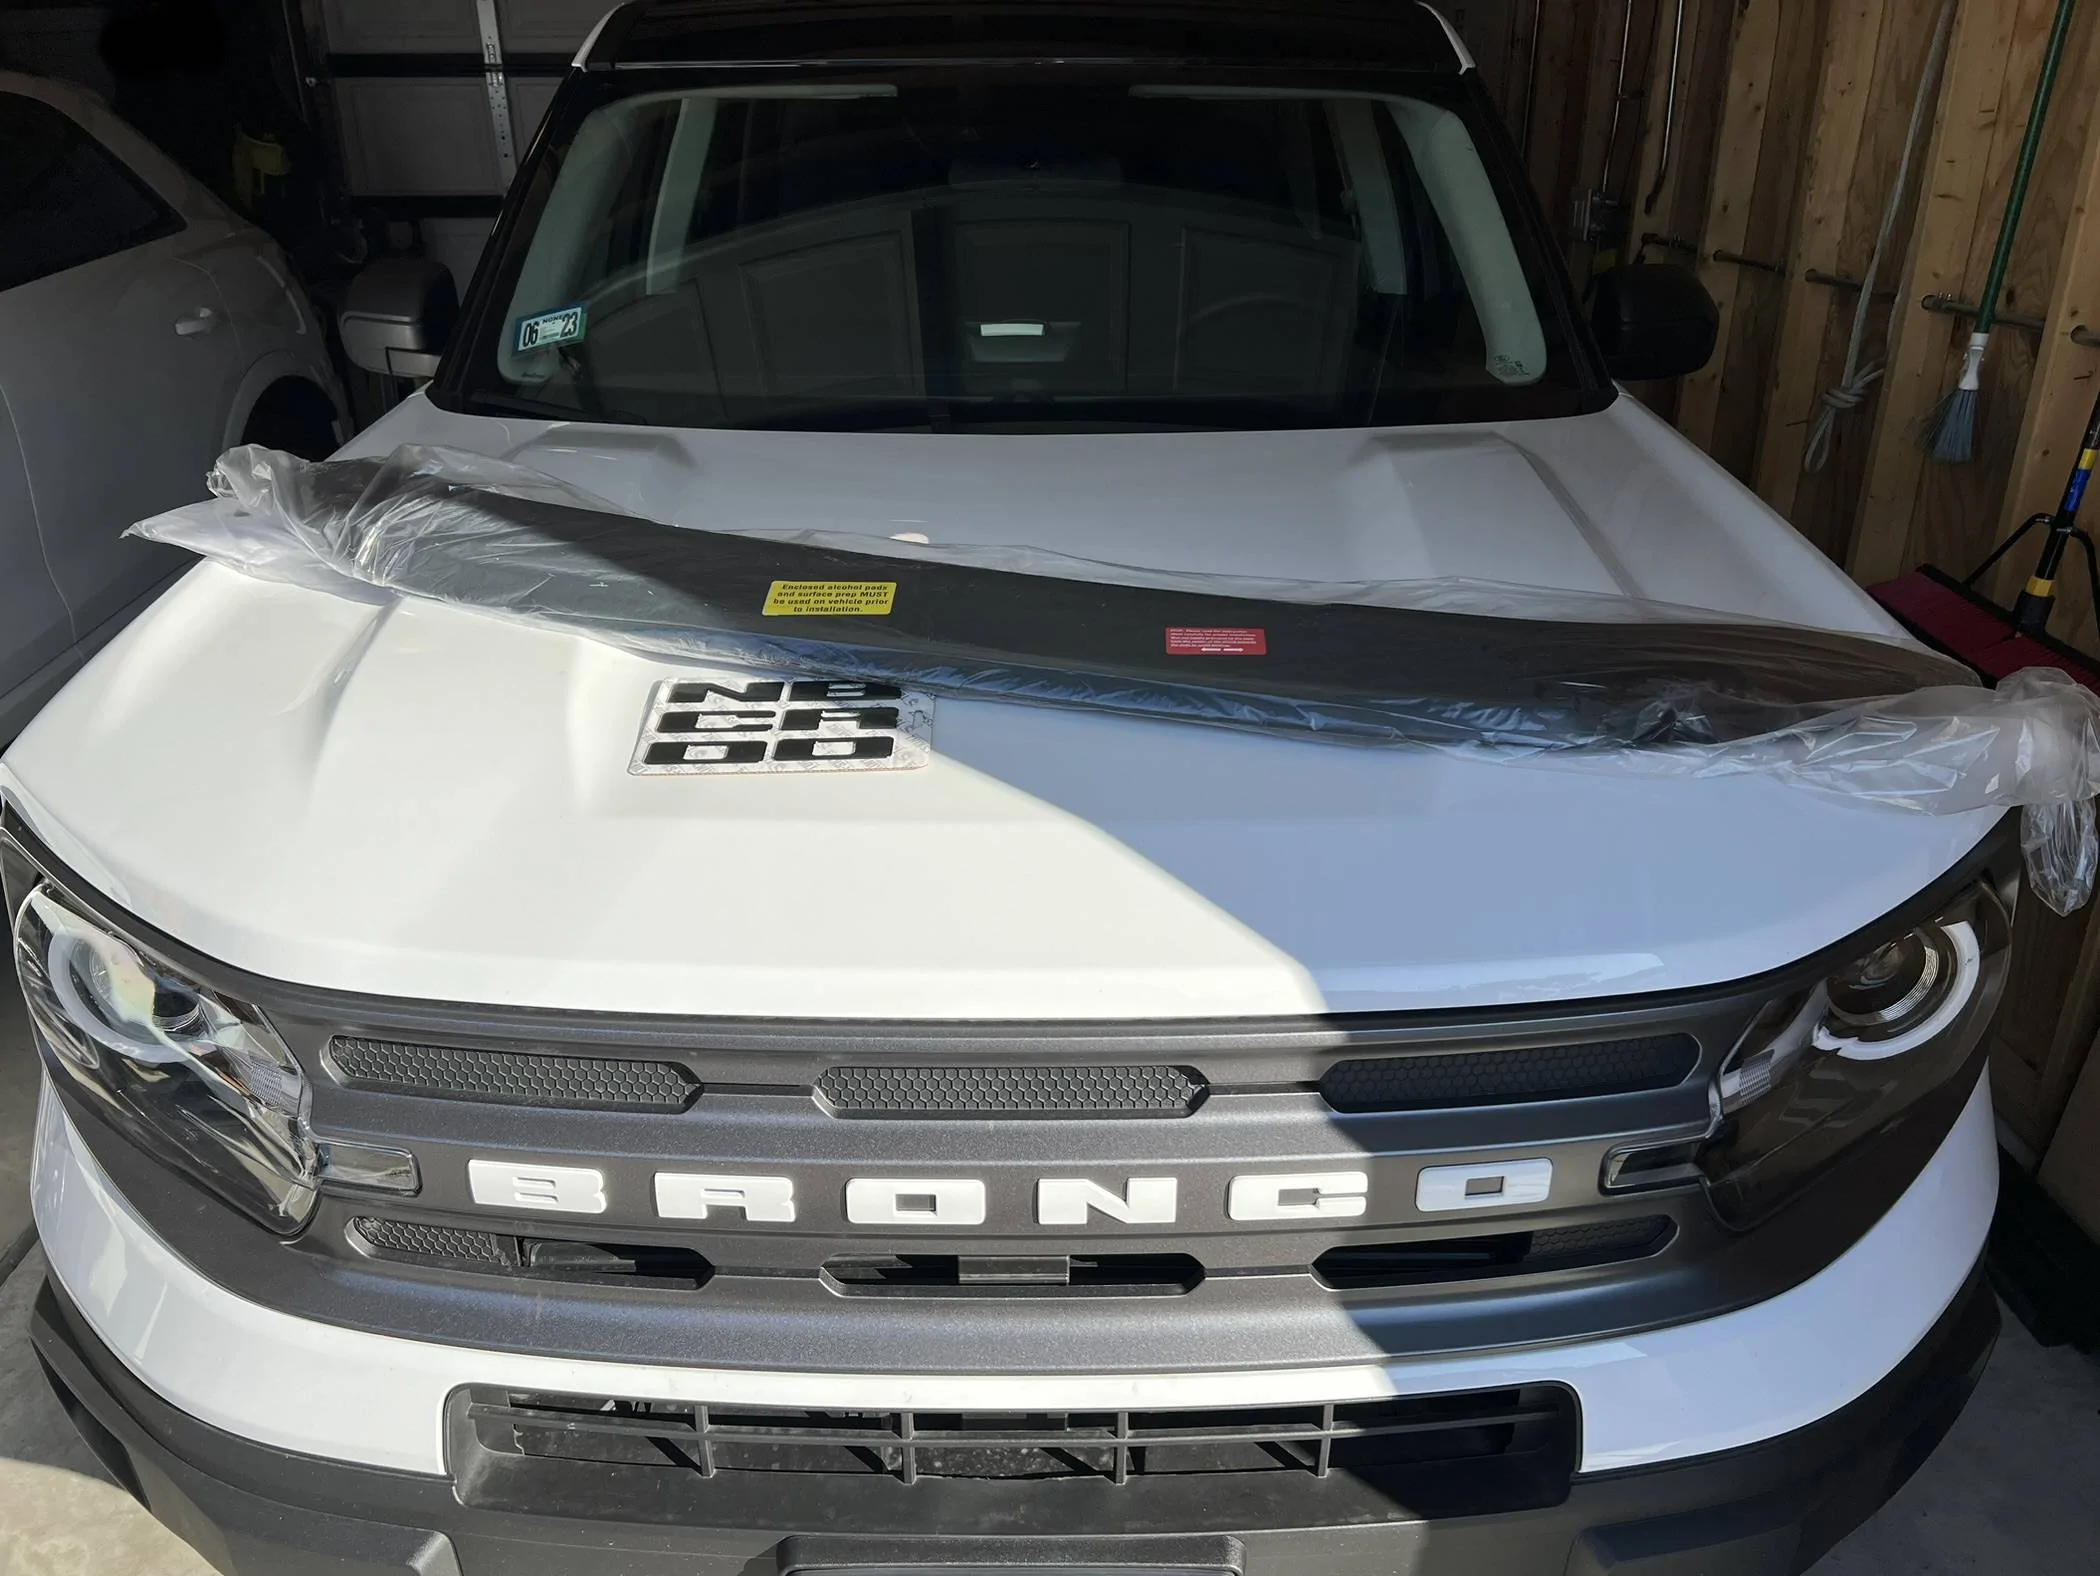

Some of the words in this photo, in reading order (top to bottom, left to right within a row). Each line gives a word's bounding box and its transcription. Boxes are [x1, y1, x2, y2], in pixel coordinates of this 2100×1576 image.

[523, 320, 541, 347] 06
[560, 311, 578, 338] 23
[467, 1157, 1553, 1226] BRONCO
